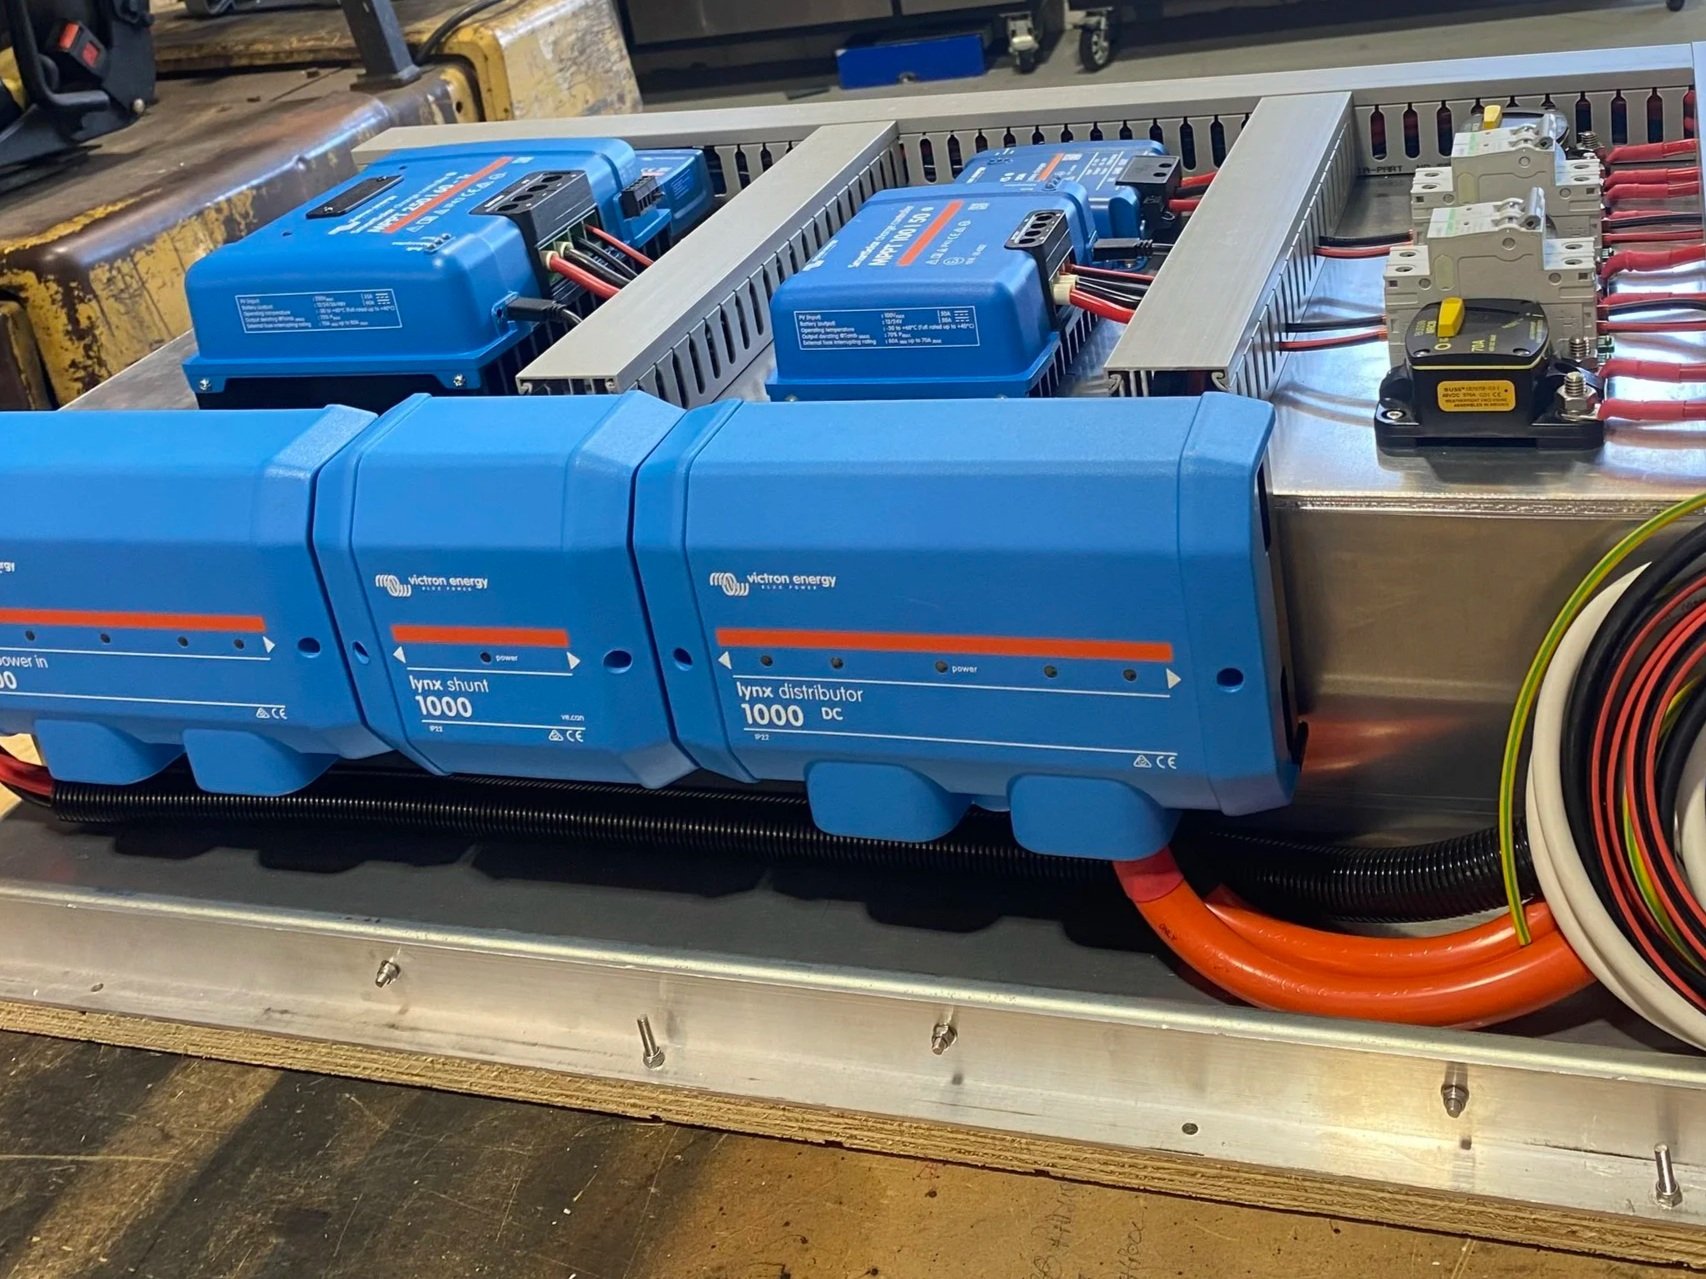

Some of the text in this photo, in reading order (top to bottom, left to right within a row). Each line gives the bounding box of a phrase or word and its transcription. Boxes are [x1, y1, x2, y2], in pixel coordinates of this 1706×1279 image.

[867, 244, 904, 266] MPPT
[408, 574, 488, 589] victron energy
[747, 572, 837, 588] victron energy
[0, 654, 48, 668] ower in
[495, 654, 518, 663] power
[952, 664, 978, 674] power
[409, 675, 489, 693] lynx shunt
[736, 681, 864, 702] lynx distributor
[415, 695, 473, 718] 1000
[741, 703, 844, 727] 1000 DC
[754, 733, 769, 741] IP22
